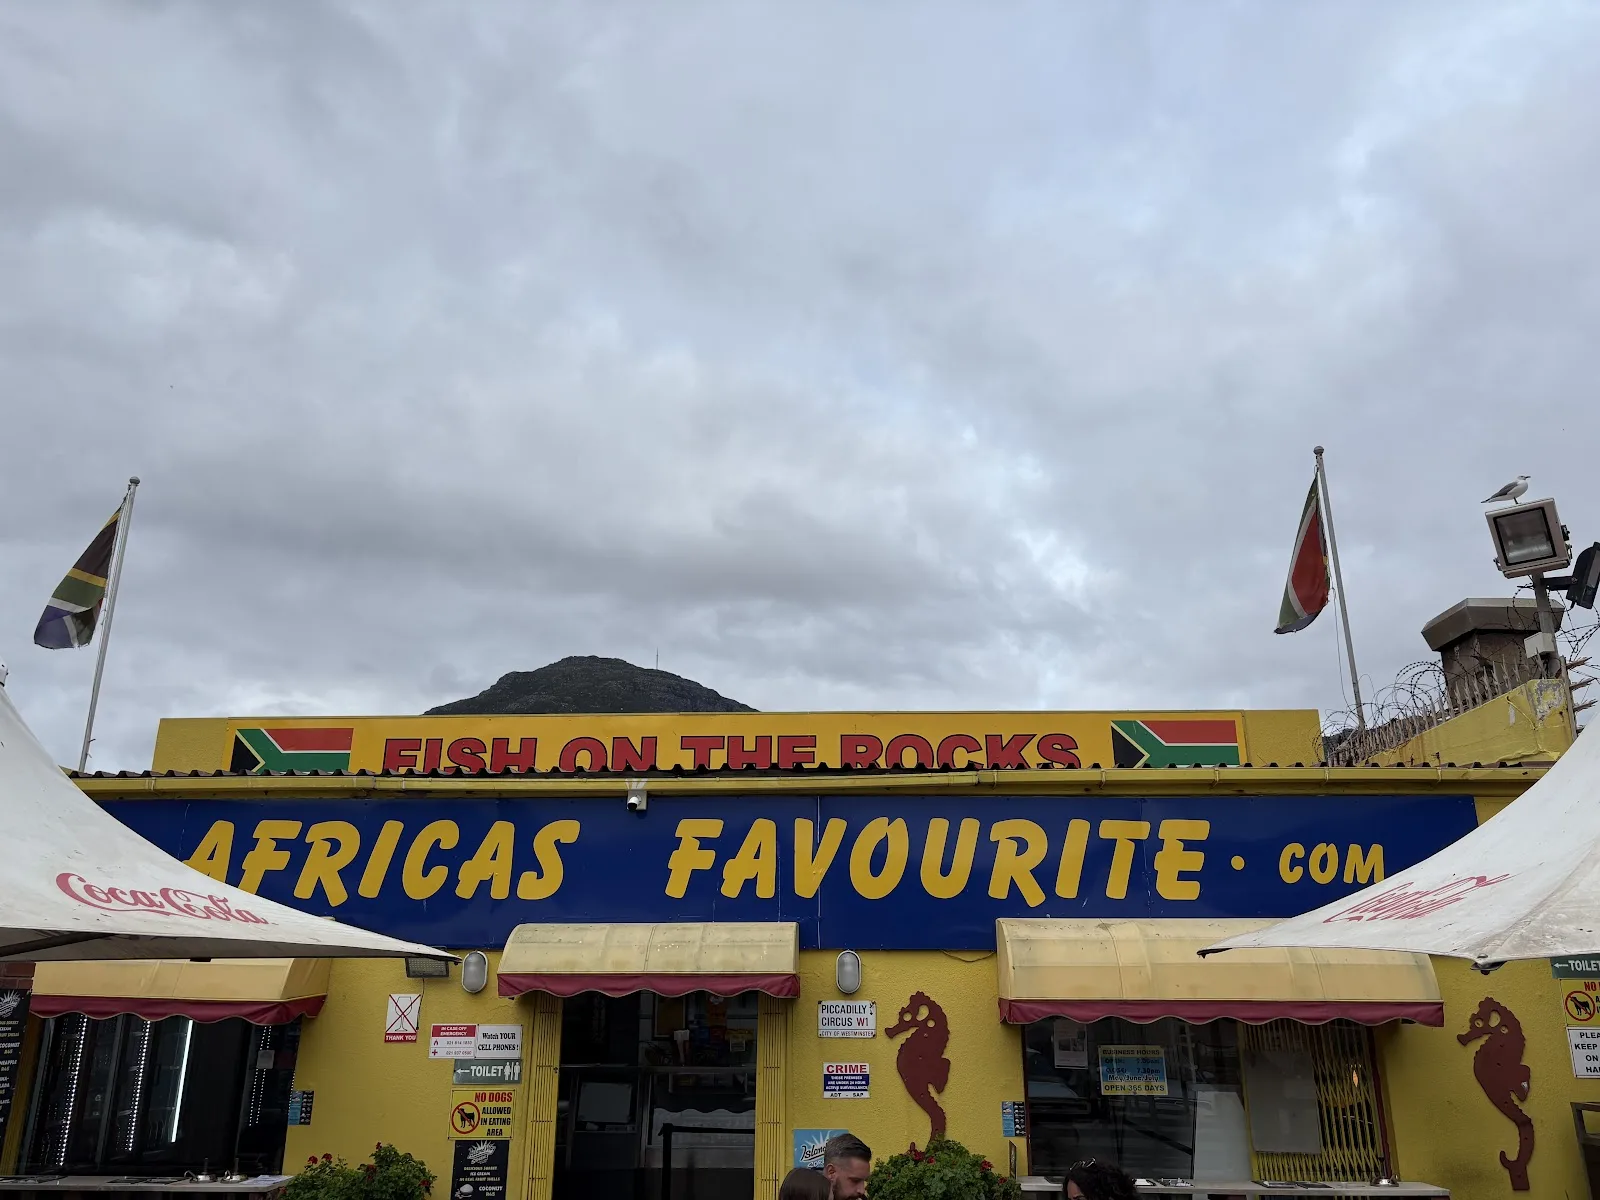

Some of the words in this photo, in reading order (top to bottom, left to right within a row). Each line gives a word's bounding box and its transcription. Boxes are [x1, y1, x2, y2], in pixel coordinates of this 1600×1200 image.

[382, 738, 538, 773] FISH
[559, 736, 657, 772] ON
[680, 735, 817, 769] THE
[840, 734, 1080, 768] ROCKS
[182, 820, 580, 907] AFRICAS
[664, 817, 1210, 908] FAVOURITE
[56, 872, 269, 924] Coca-Cola
[1584, 982, 1596, 991] NO
[822, 1004, 866, 1014] PICCADILLY
[822, 1016, 852, 1026] CIRCUS
[856, 1017, 868, 1026] W1
[470, 1066, 503, 1077] TOILET
[826, 1065, 867, 1073] CRIME
[474, 1092, 486, 1102] NO
[489, 1092, 512, 1102] DOGS
